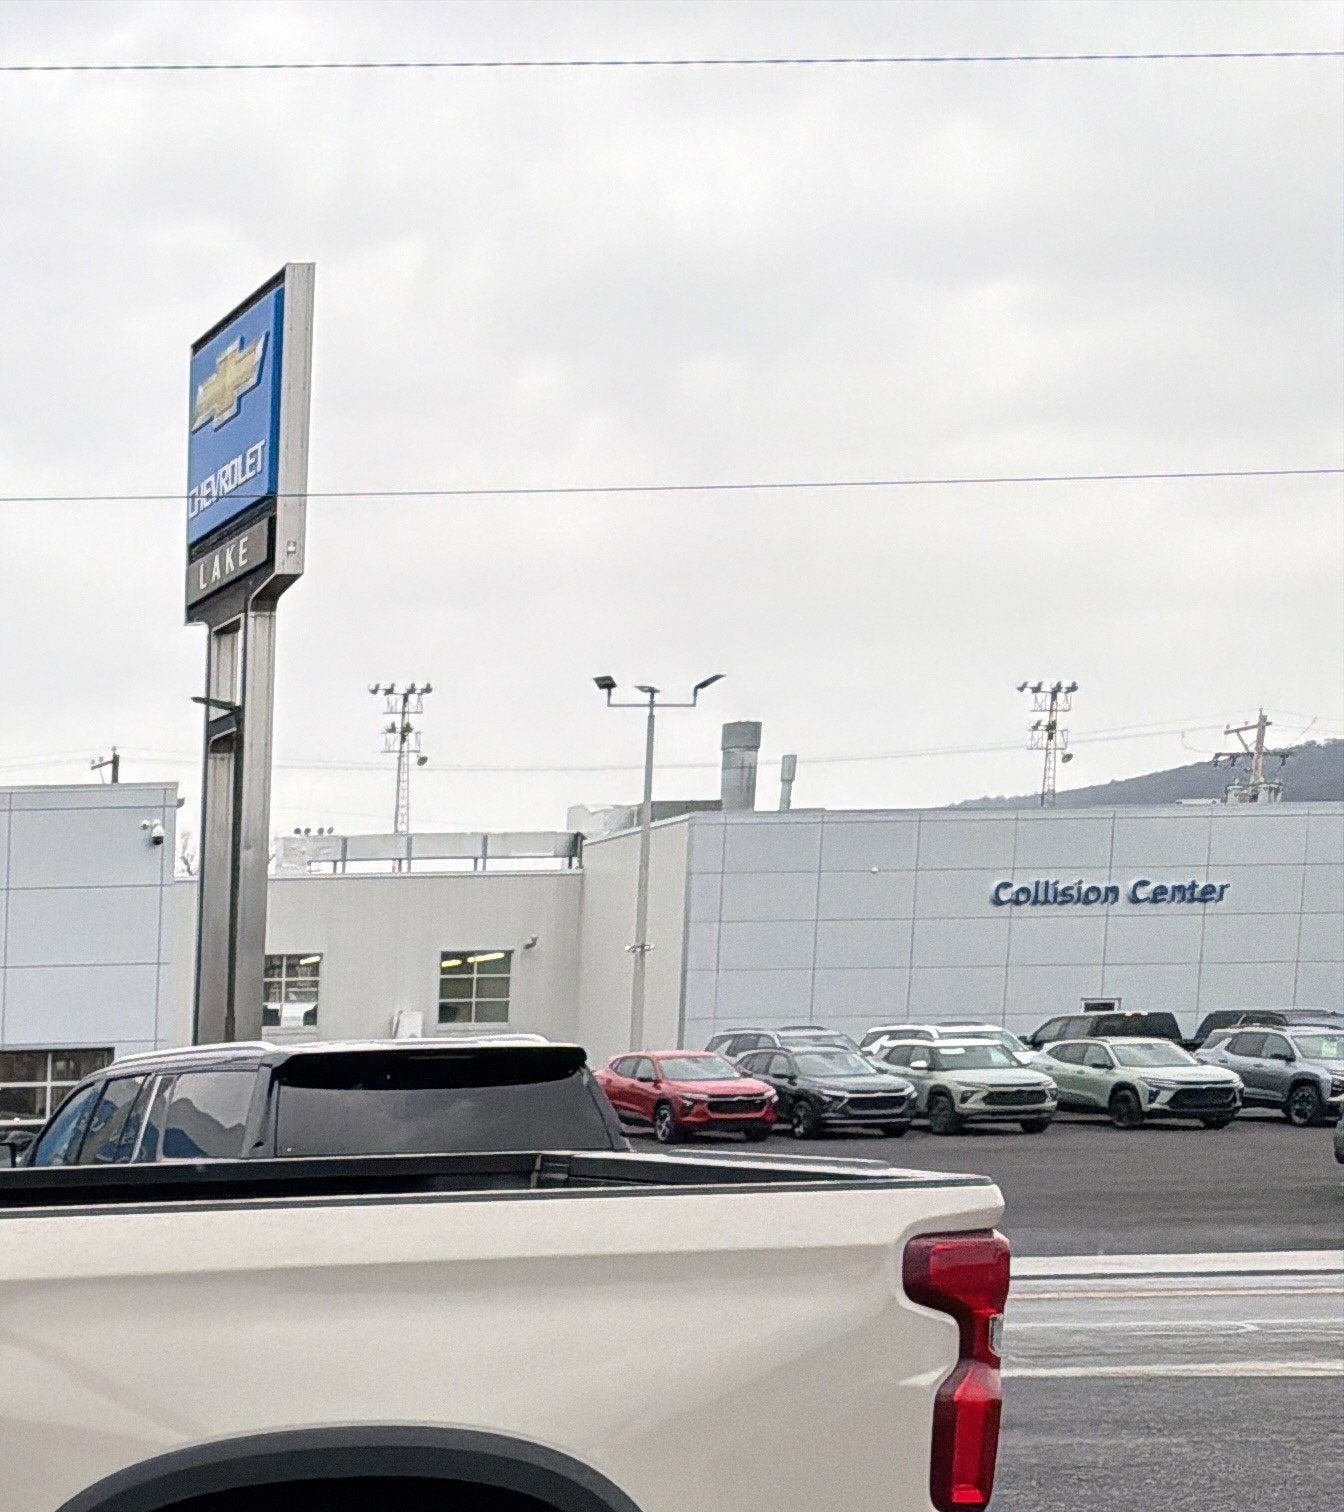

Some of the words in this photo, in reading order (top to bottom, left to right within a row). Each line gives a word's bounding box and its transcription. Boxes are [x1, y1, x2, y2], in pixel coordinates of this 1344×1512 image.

[188, 439, 266, 519] CHEVROLET
[199, 536, 248, 590] LAKE
[990, 879, 1120, 907] Collision
[1126, 879, 1230, 905] Center
